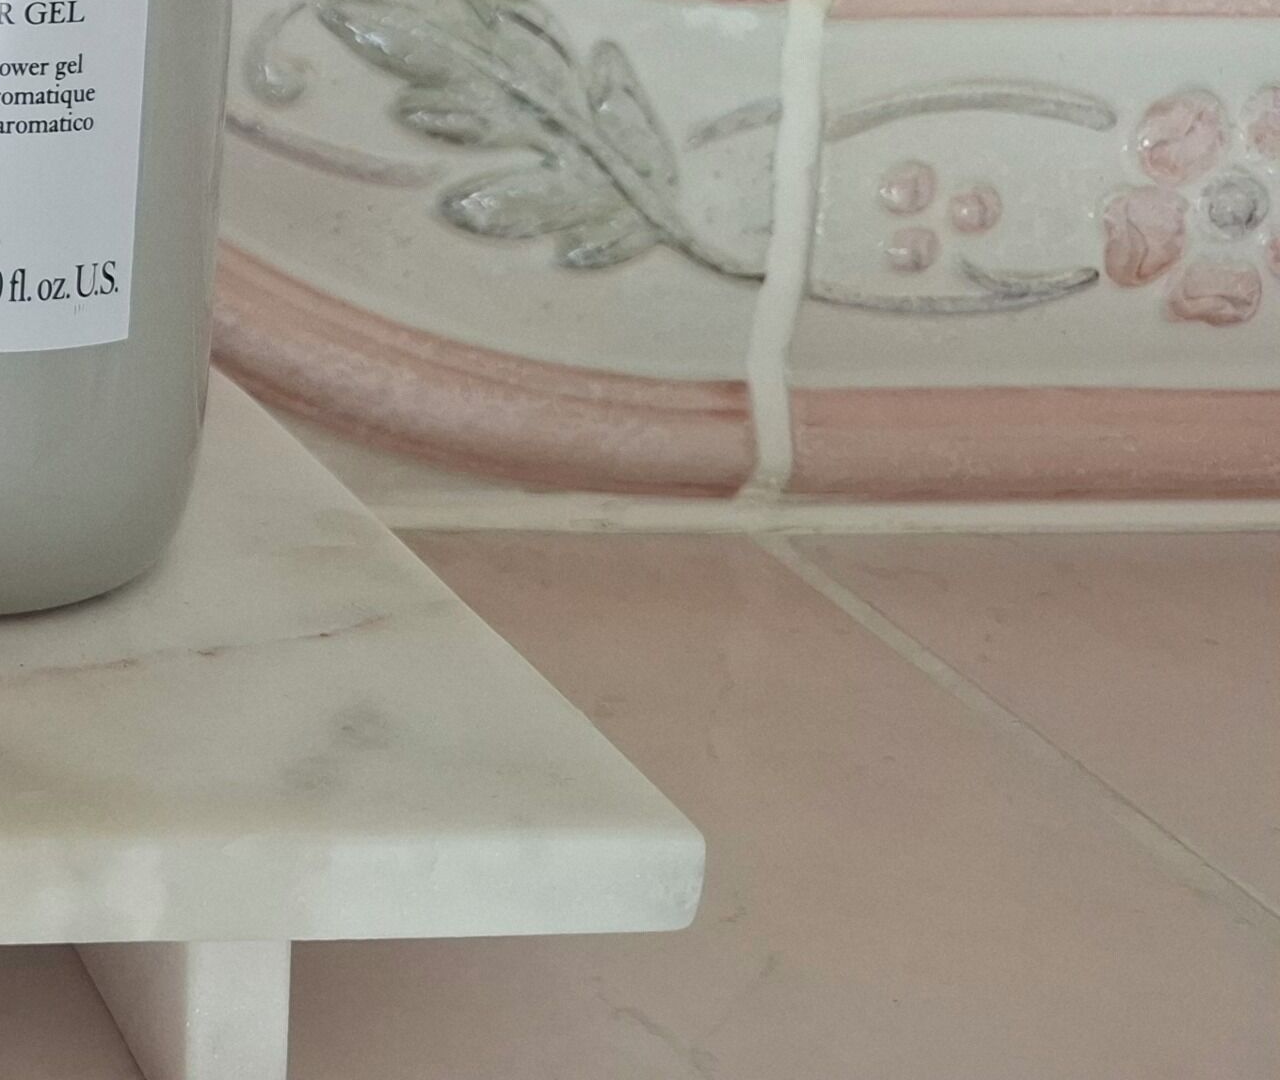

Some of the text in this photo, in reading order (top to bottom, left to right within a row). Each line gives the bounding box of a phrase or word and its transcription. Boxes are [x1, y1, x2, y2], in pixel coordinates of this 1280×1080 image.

[24, 0, 86, 26] GEL
[54, 52, 84, 81] gel
[7, 267, 33, 303] fl.
[36, 277, 71, 302] oz.
[75, 259, 119, 298] U.S.
